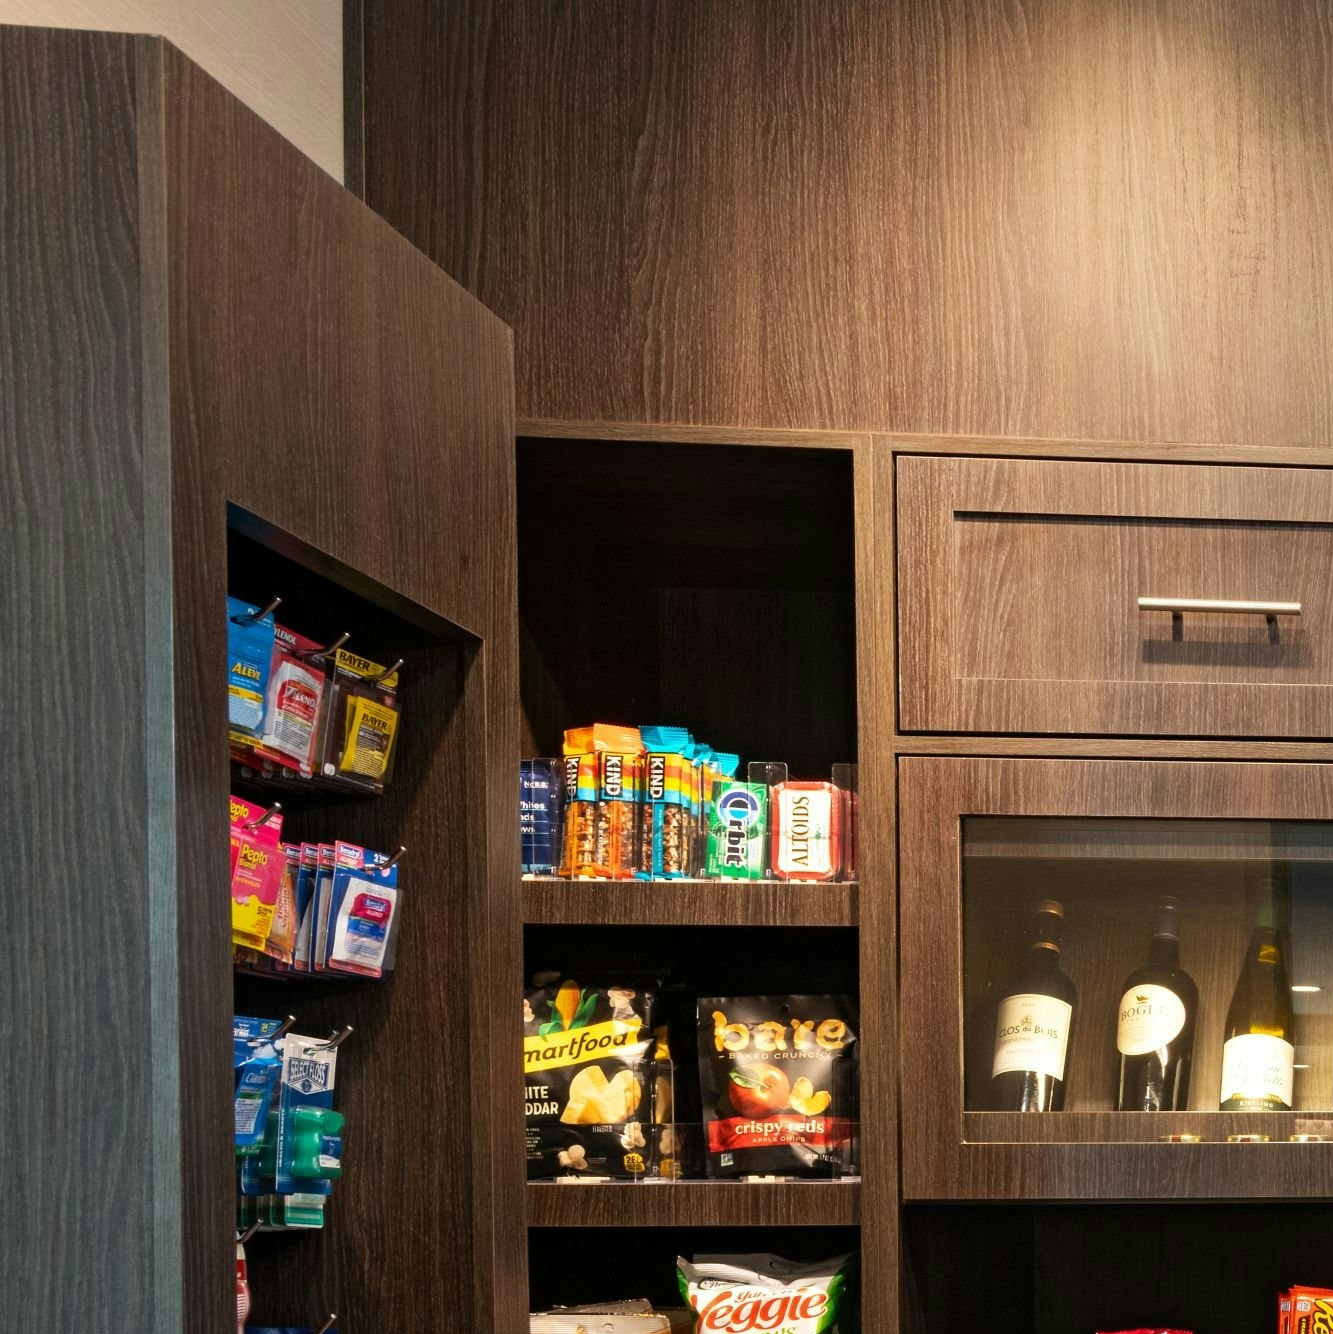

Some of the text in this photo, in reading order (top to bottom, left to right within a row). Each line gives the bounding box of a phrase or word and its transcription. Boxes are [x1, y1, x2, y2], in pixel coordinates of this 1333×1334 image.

[339, 651, 370, 671] BAYER
[362, 713, 388, 731] BAYER
[565, 757, 580, 797] KIND
[605, 755, 622, 796] KIND
[650, 757, 665, 799] KIND
[792, 796, 811, 867] ALTOIDS
[241, 843, 268, 865] Pepto
[524, 1031, 628, 1063] martfood
[712, 1010, 845, 1052] bare
[689, 1286, 829, 1333] Veggie
